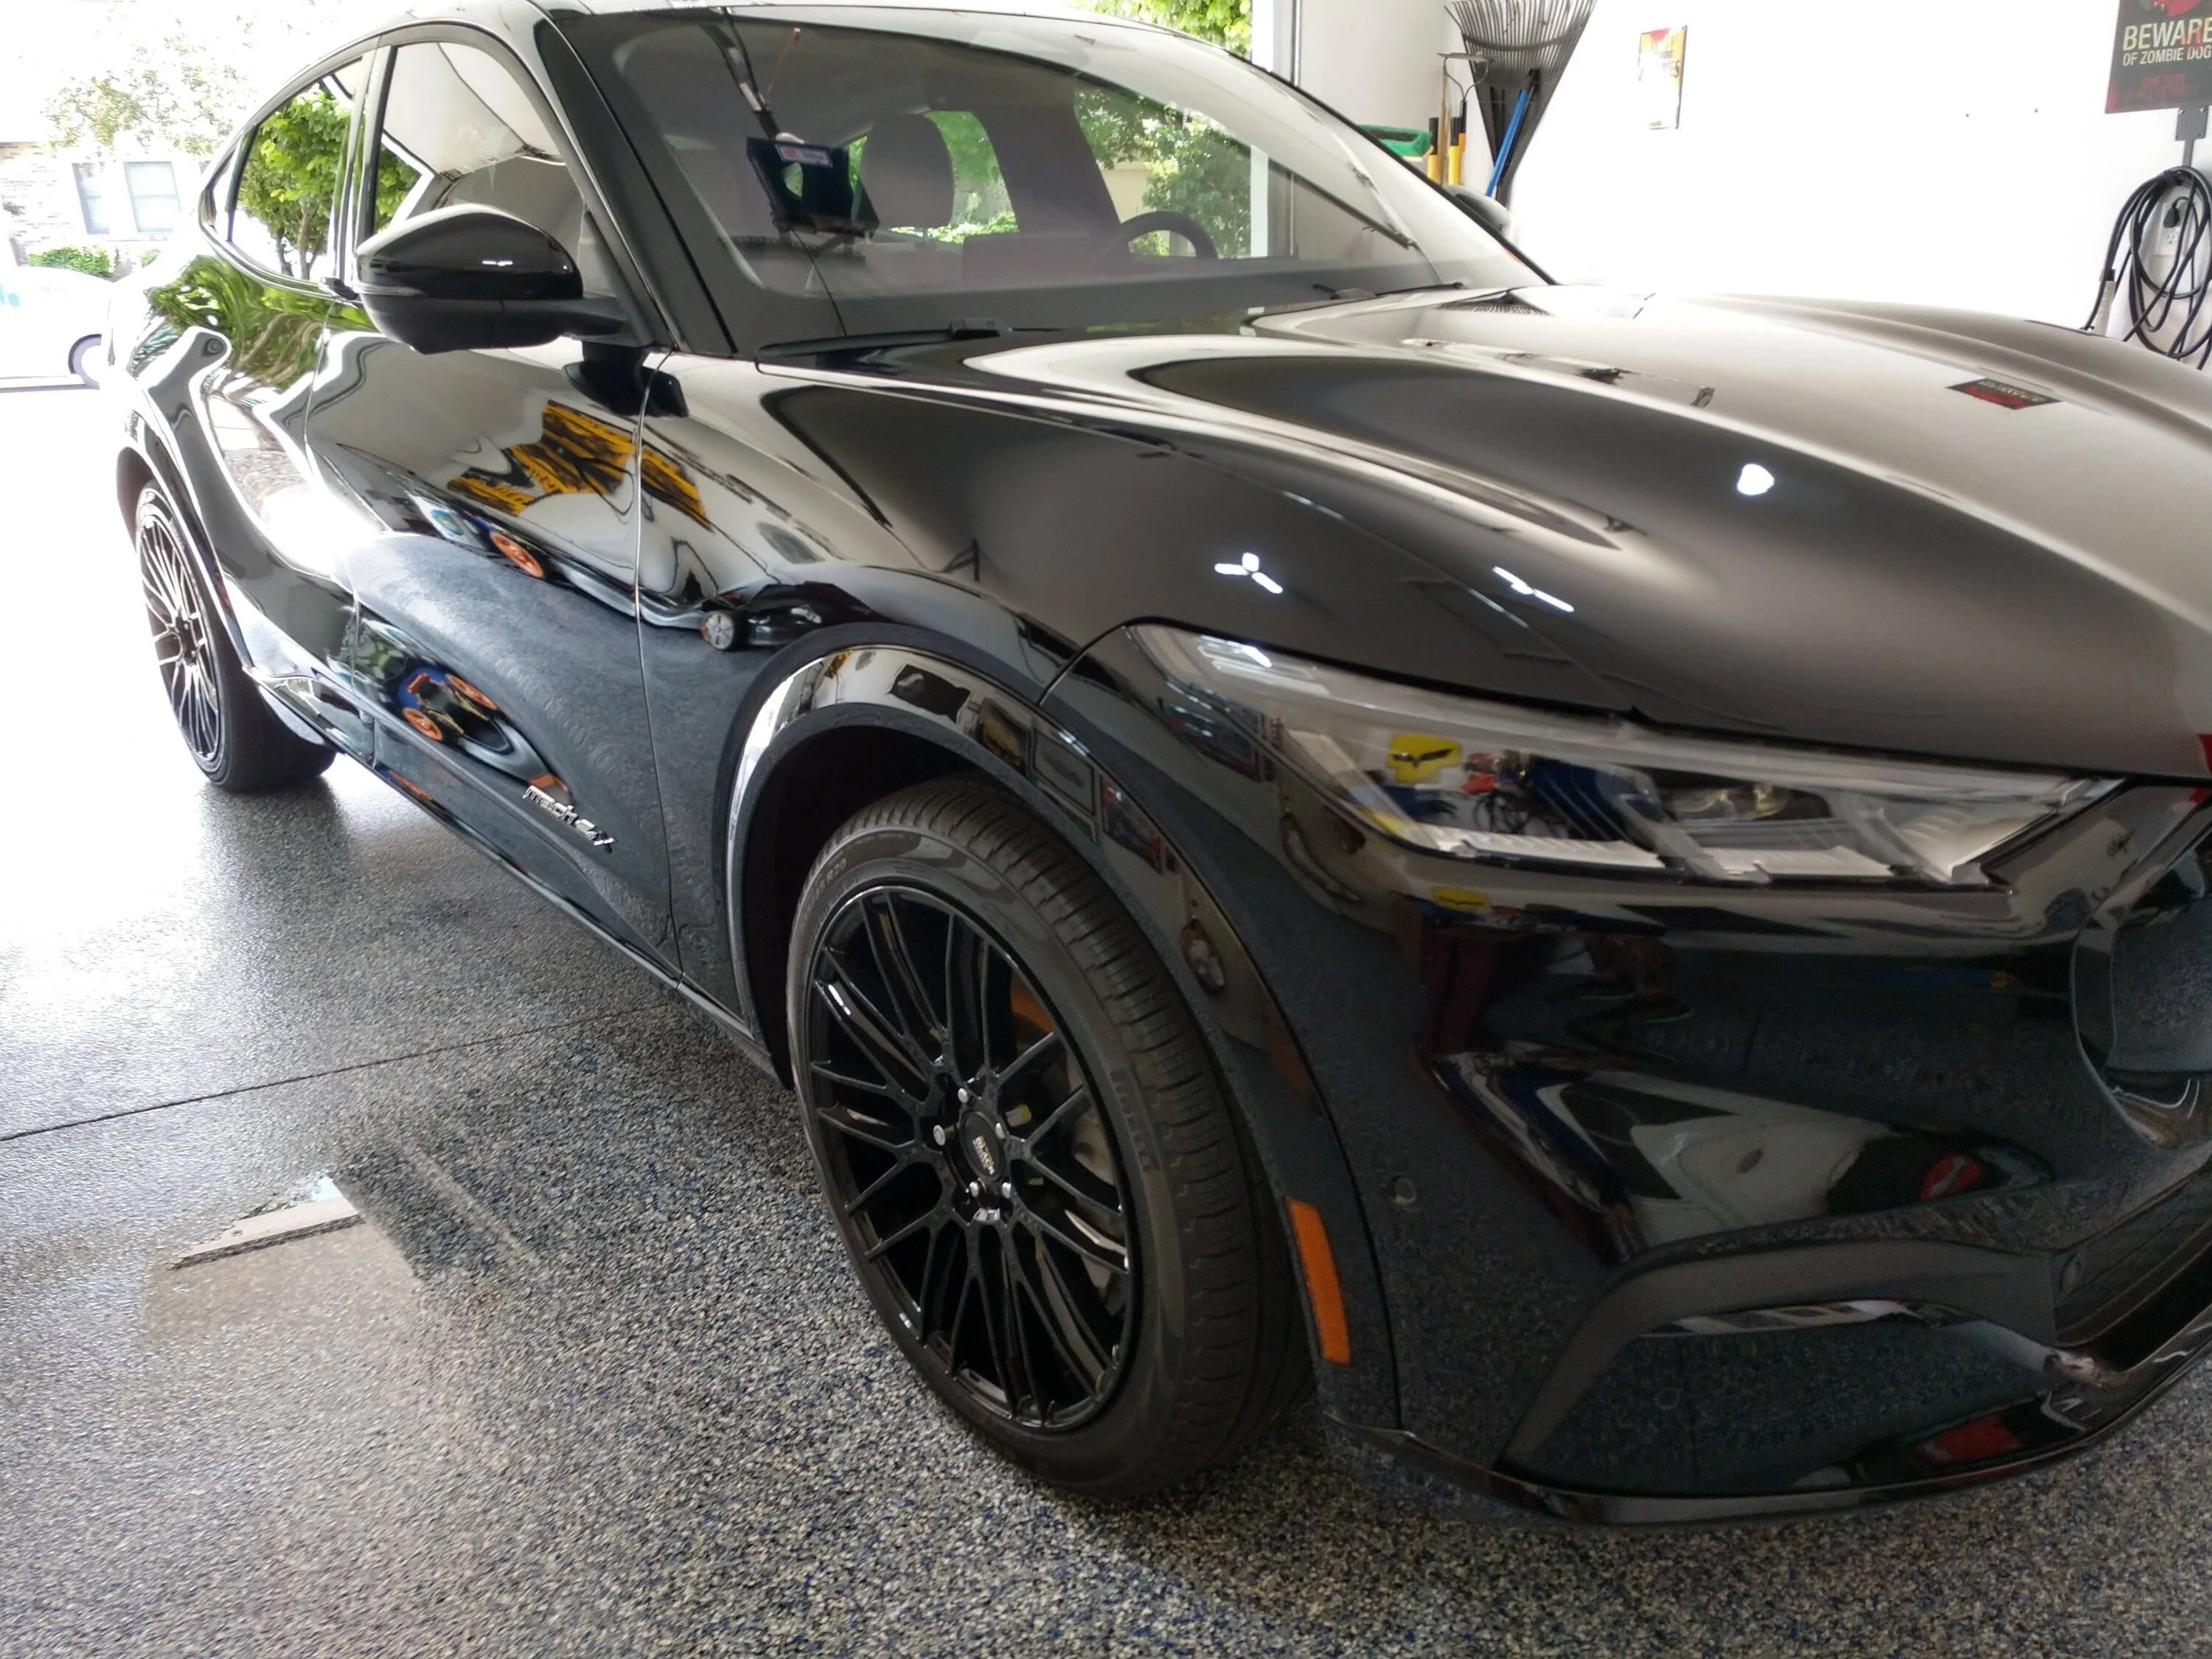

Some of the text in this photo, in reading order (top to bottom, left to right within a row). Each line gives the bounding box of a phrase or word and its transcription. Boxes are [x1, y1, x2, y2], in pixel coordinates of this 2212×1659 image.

[2123, 17, 2212, 51] BEWARE
[2122, 52, 2138, 66] OF
[2139, 47, 2185, 65] ZOMBIE
